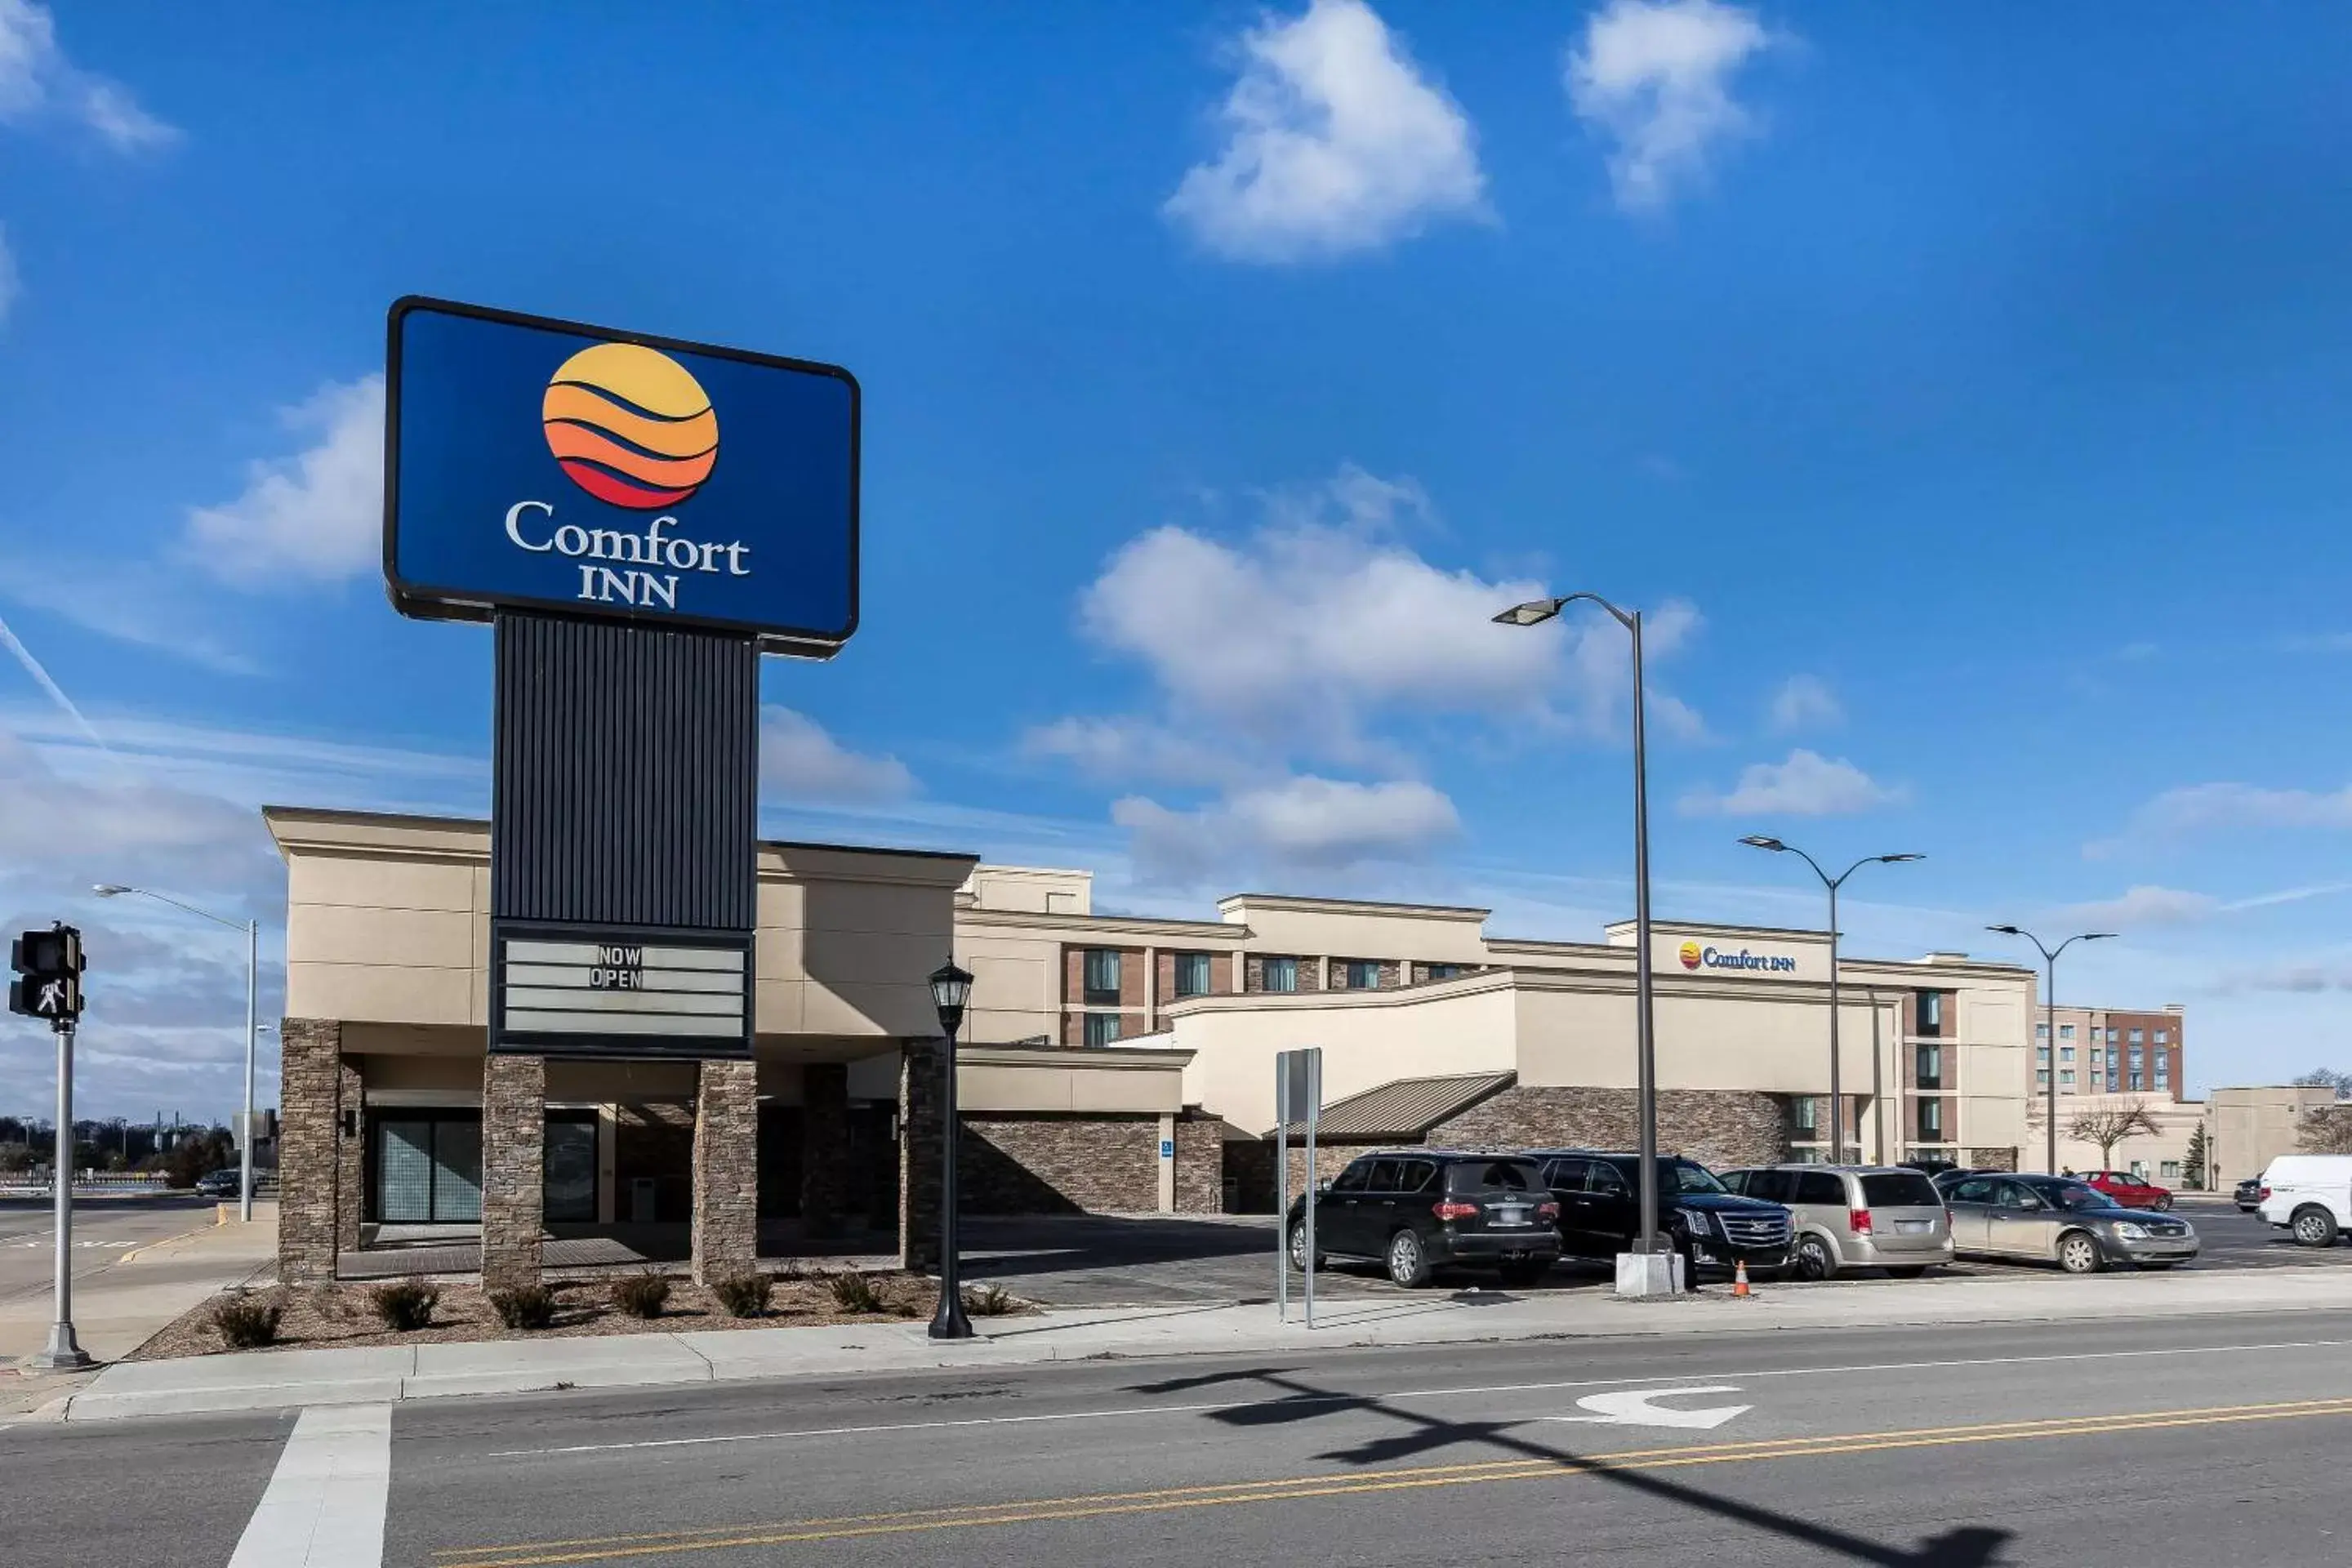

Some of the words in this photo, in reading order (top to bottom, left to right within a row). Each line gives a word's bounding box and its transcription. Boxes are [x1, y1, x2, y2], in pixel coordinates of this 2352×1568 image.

[505, 501, 751, 575] Comfort
[577, 565, 679, 608] INN
[600, 947, 640, 964] NOW
[1703, 947, 1769, 971] Comfort
[1771, 956, 1796, 972] INN
[590, 969, 642, 988] OPEN
